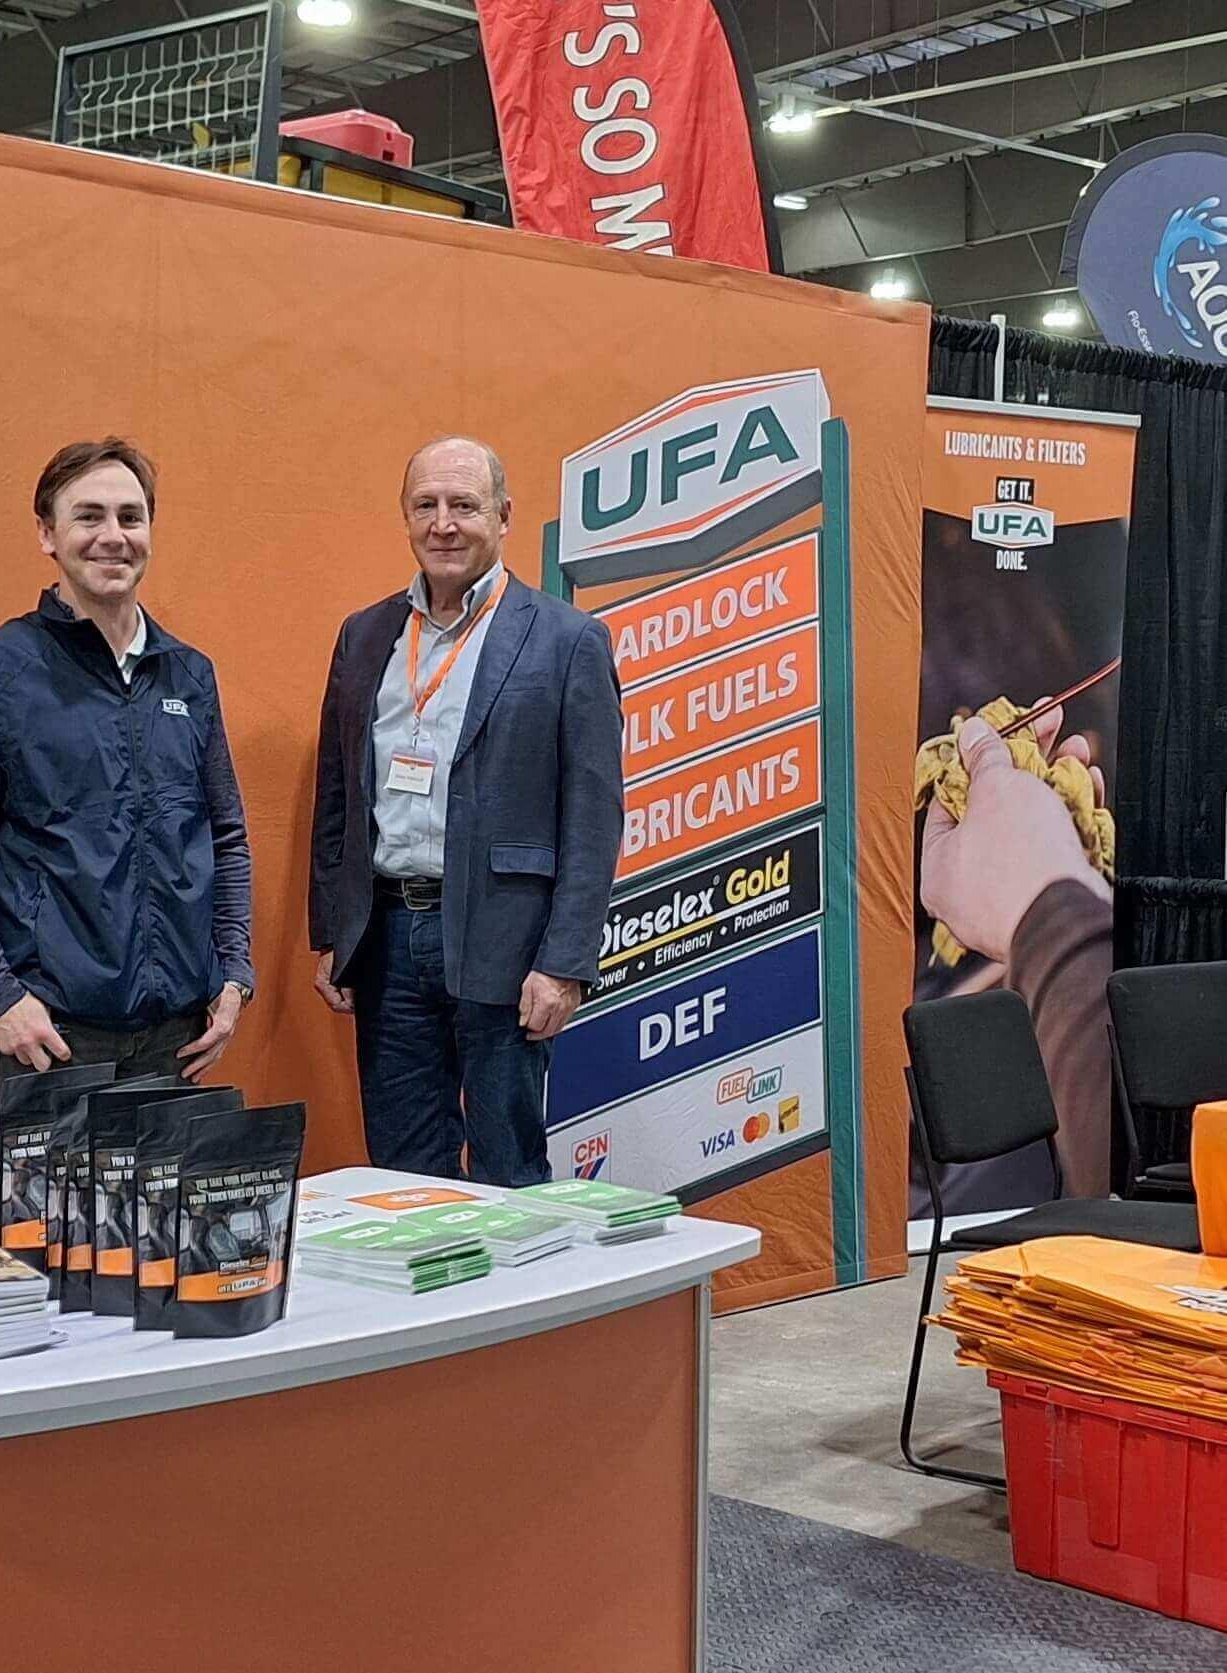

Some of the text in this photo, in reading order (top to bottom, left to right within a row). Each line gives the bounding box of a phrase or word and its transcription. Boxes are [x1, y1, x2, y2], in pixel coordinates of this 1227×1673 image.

[588, 183, 675, 257] M
[582, 405, 799, 531] UFA
[945, 430, 1086, 465] LUBRICANTS & FILTERS
[997, 479, 1032, 500] GET IT.
[978, 513, 1047, 537] UFA
[996, 550, 1027, 570] DONE.
[614, 566, 788, 668] ARDLOCK
[622, 651, 798, 755] LK FUELS
[623, 747, 800, 857] BRICANTS
[725, 850, 790, 904] Gold
[588, 899, 789, 995] ower Efficiency Protection
[639, 986, 726, 1061] DEF
[721, 1074, 778, 1098] FUEL LINK
[574, 1134, 608, 1164] CFN
[700, 1129, 735, 1158] VISA
